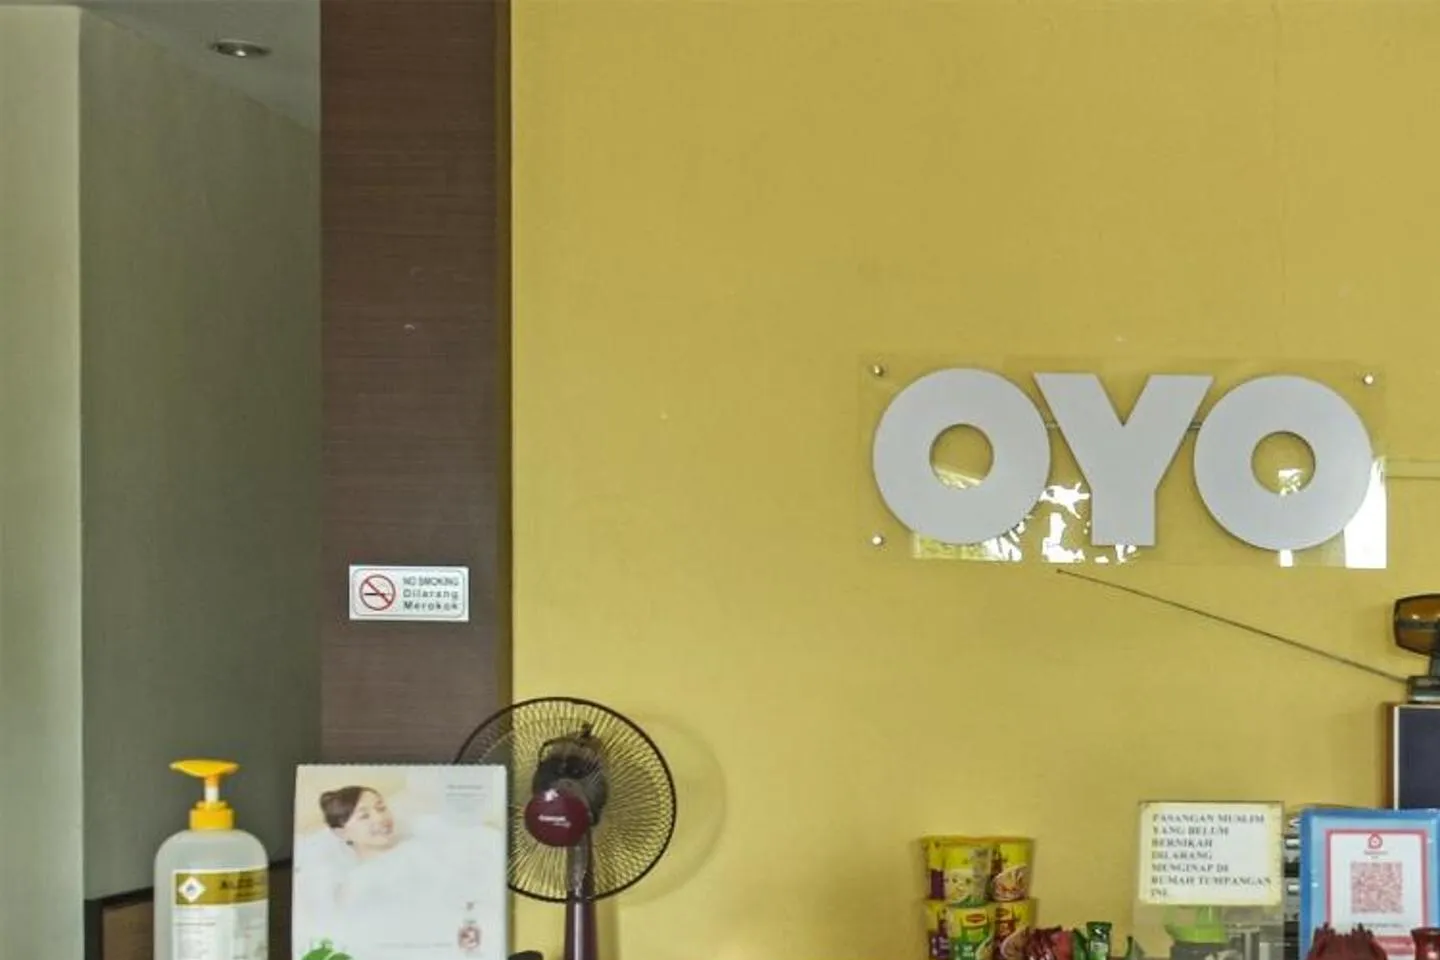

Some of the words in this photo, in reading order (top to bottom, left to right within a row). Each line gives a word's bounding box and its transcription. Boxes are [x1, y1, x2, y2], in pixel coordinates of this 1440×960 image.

[872, 367, 1373, 552] OYO
[403, 589, 459, 600] Dilarang
[404, 600, 458, 610] Merokok
[1153, 814, 1214, 823] PASANGAN
[1217, 814, 1265, 823] MUSLIM
